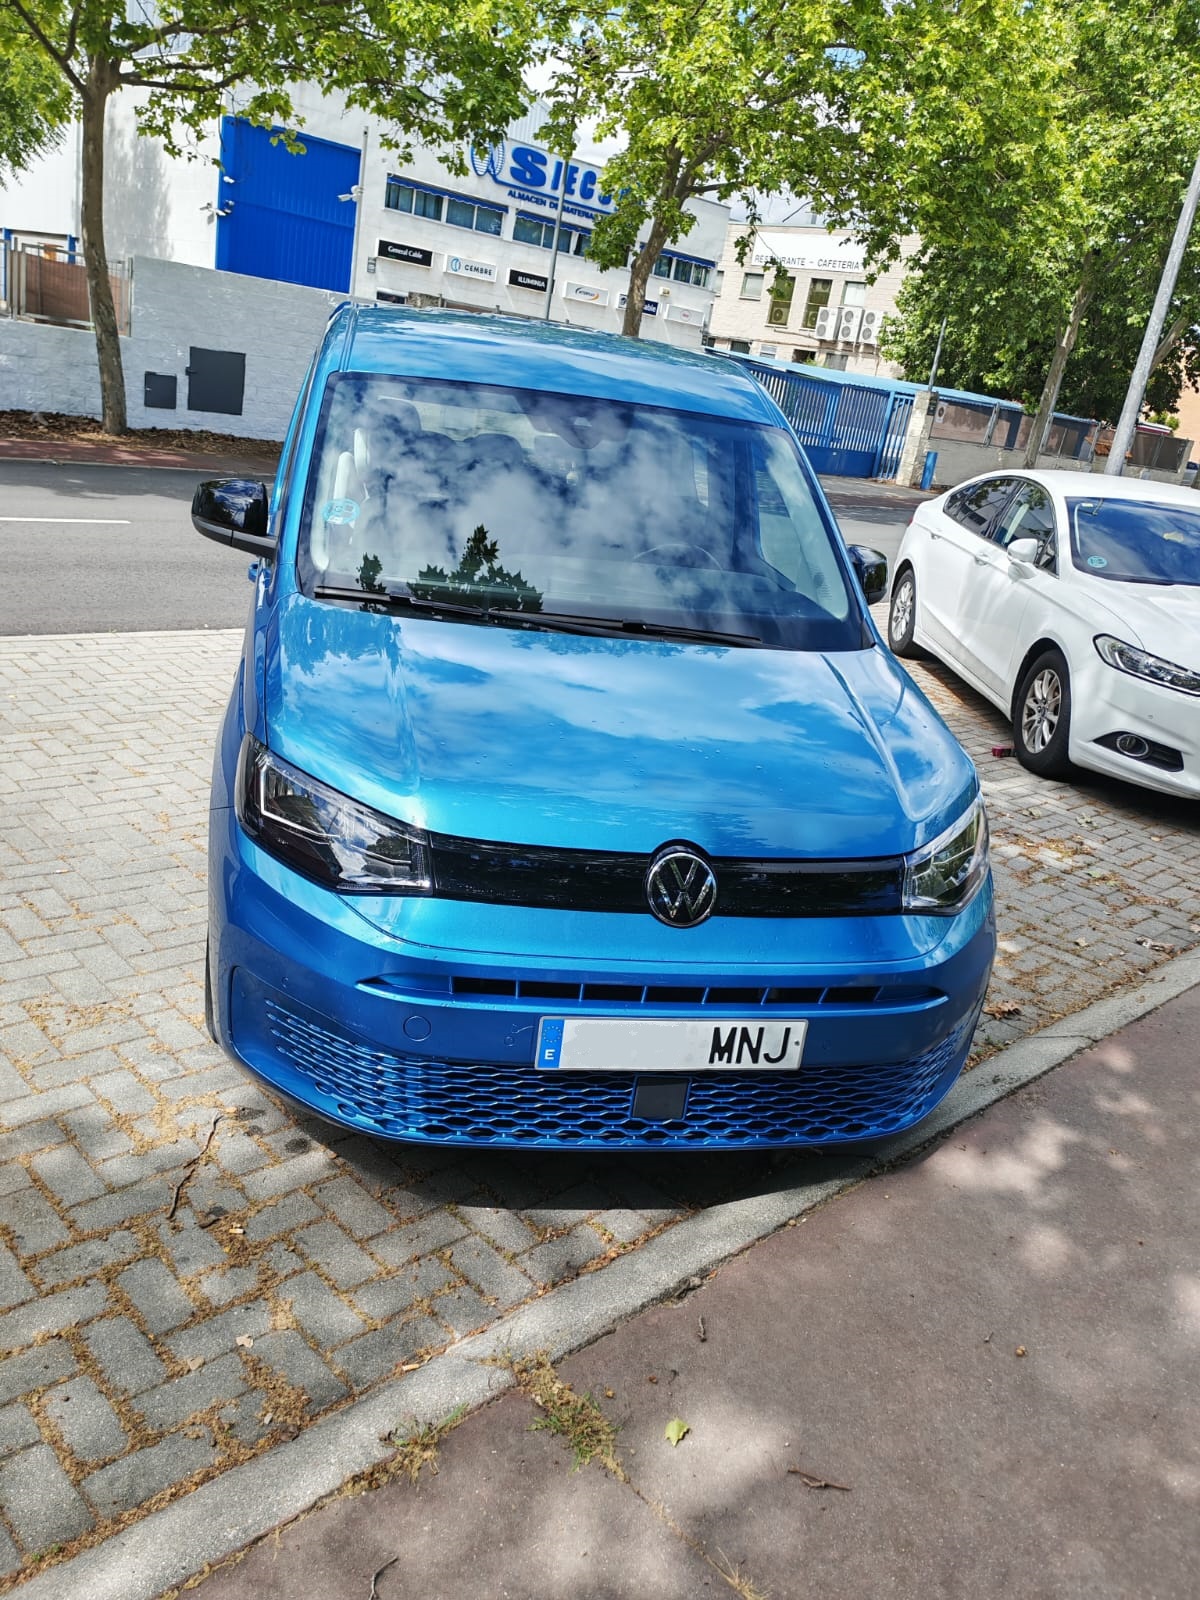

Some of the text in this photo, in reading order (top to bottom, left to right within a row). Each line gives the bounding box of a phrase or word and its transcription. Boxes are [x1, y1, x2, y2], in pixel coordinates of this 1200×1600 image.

[507, 189, 547, 207] ALMACEN
[408, 250, 423, 259] Cable
[464, 264, 492, 276] CEMBRE
[817, 259, 860, 270] CAFETERIA
[709, 1027, 791, 1064] MNJ
[544, 1049, 556, 1061] E
